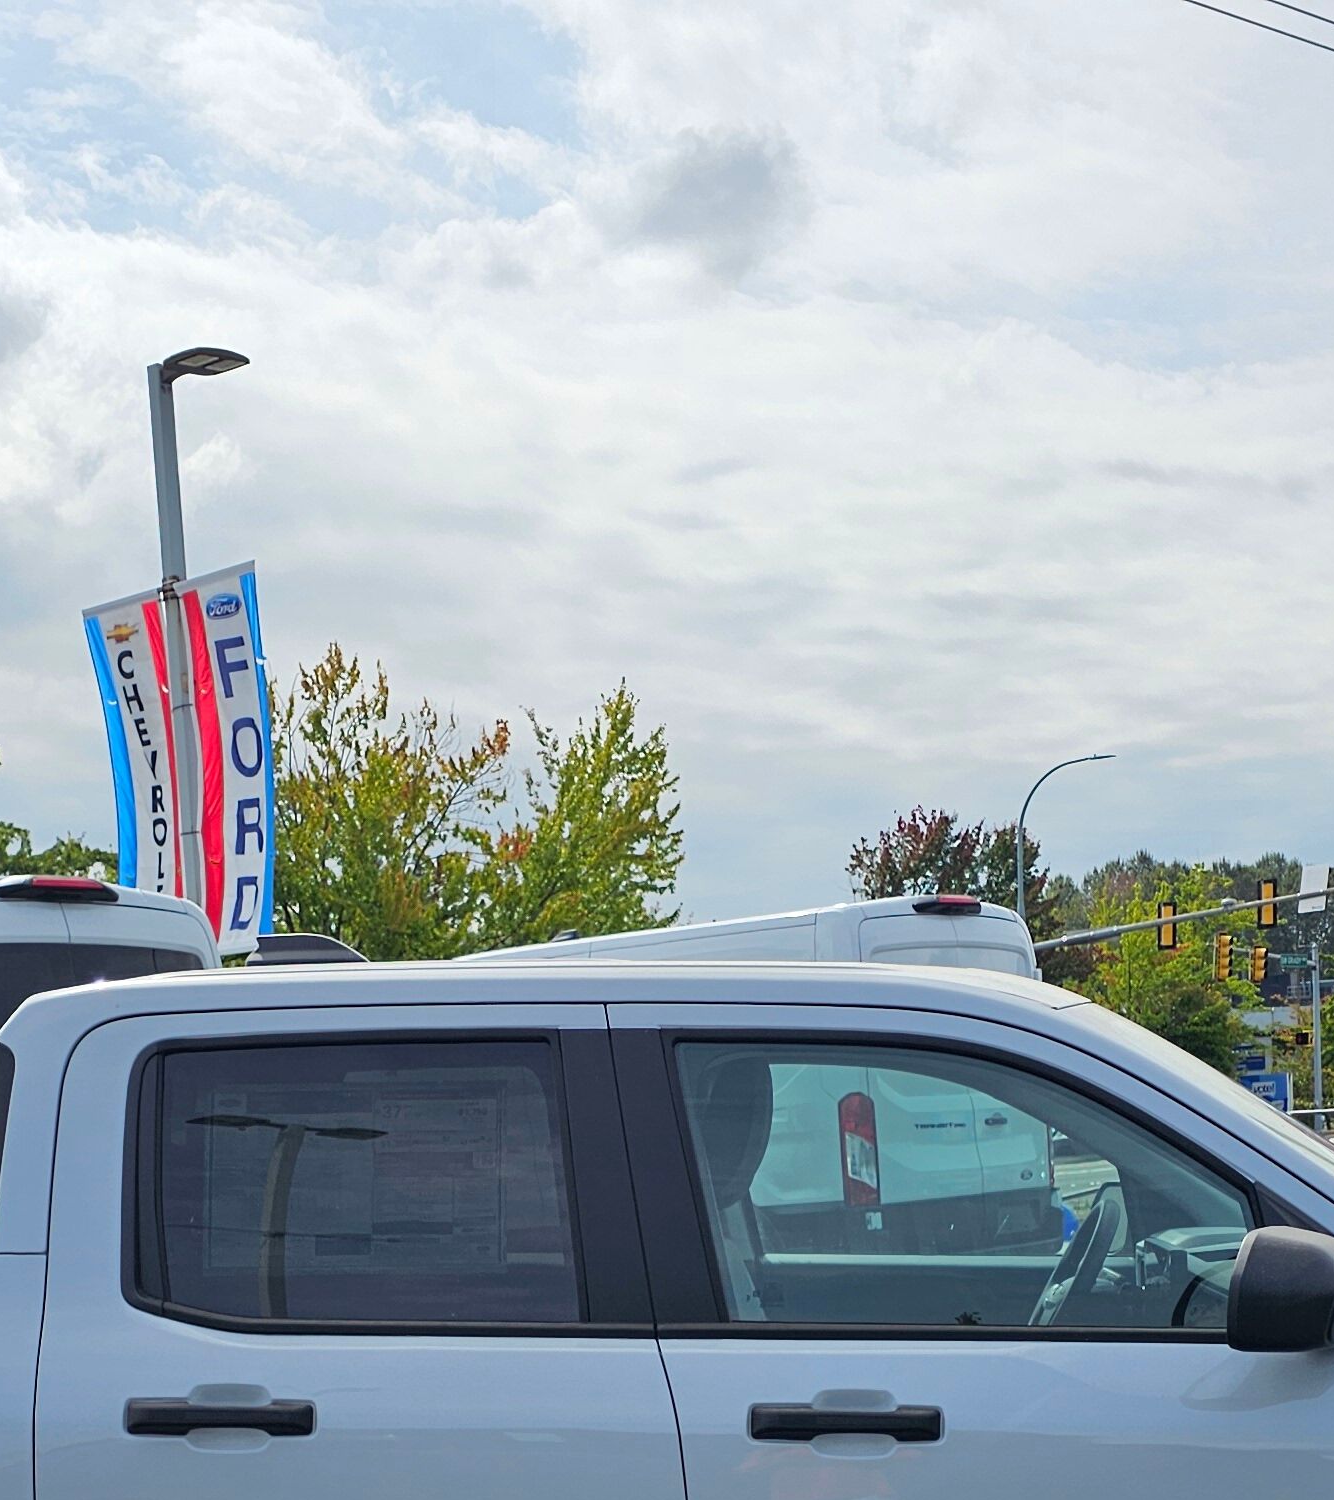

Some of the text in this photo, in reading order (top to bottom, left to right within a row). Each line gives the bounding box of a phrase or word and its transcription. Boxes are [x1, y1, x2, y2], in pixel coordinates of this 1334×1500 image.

[209, 599, 238, 617] Ford
[117, 650, 168, 892] CHEVROL
[214, 635, 264, 931] FORD
